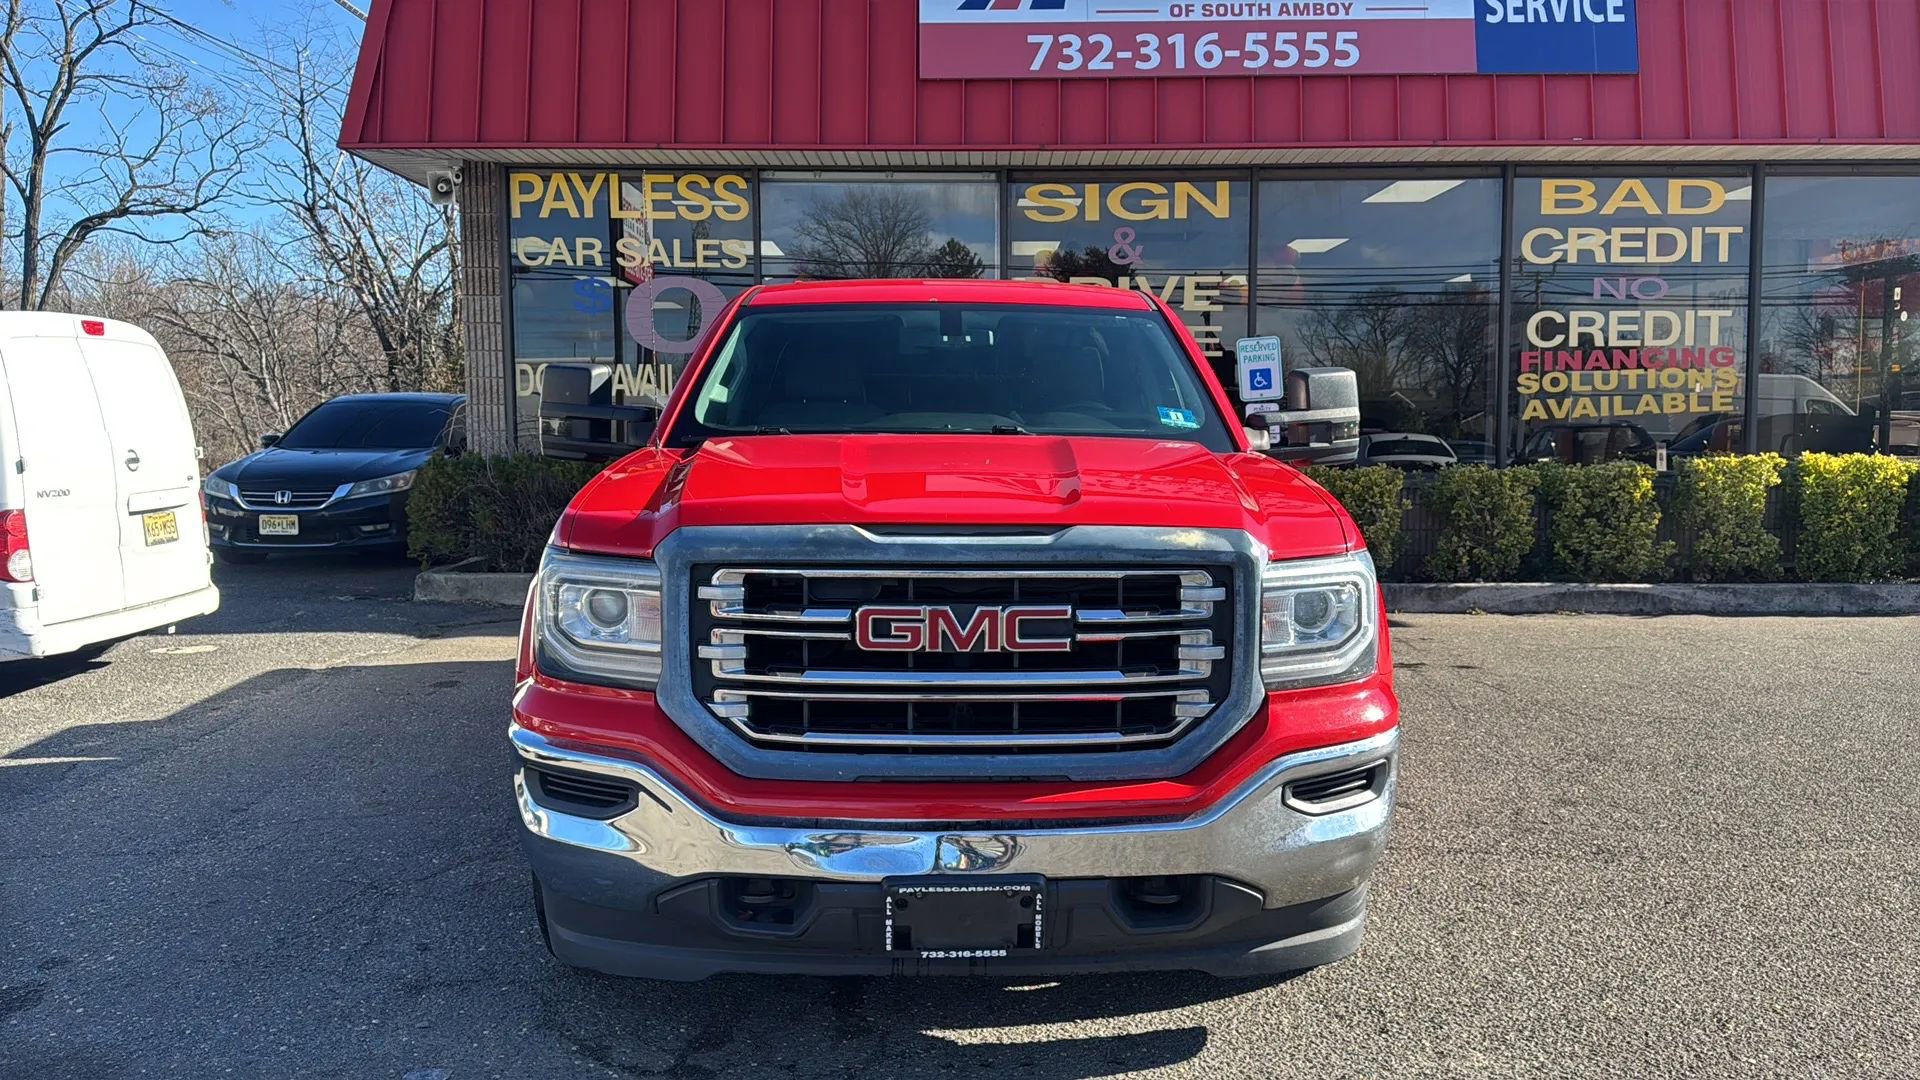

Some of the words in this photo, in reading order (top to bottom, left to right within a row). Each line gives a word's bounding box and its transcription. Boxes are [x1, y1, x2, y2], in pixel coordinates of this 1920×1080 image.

[1169, 3, 1195, 17] OF
[1202, 3, 1271, 17] SOUTH
[1278, 2, 1353, 17] AMBOY
[1486, 0, 1625, 24] SERVICE
[1027, 31, 1360, 71] 732-316-5555
[510, 172, 750, 221] PAYLESS
[1023, 181, 1231, 222] SIGN
[1540, 179, 1728, 216] BAD
[517, 236, 603, 266] CAR
[616, 237, 747, 269] SALES
[1108, 227, 1143, 265] &
[1520, 226, 1744, 264] CREDIT
[1592, 276, 1670, 300] NO
[1526, 310, 1733, 348] CREDIT
[1240, 342, 1277, 353] RESERVED
[1243, 353, 1276, 363] PARKING
[1521, 347, 1736, 373] FINANCING
[1516, 367, 1739, 395] SOLUTIONS
[1521, 391, 1735, 421] AVAILABLE
[37, 489, 71, 498] NV200
[856, 605, 1071, 652] GMC
[899, 885, 1031, 894] PAYLESSCARSNJ.COM
[921, 949, 1007, 959] 732-316-5555
